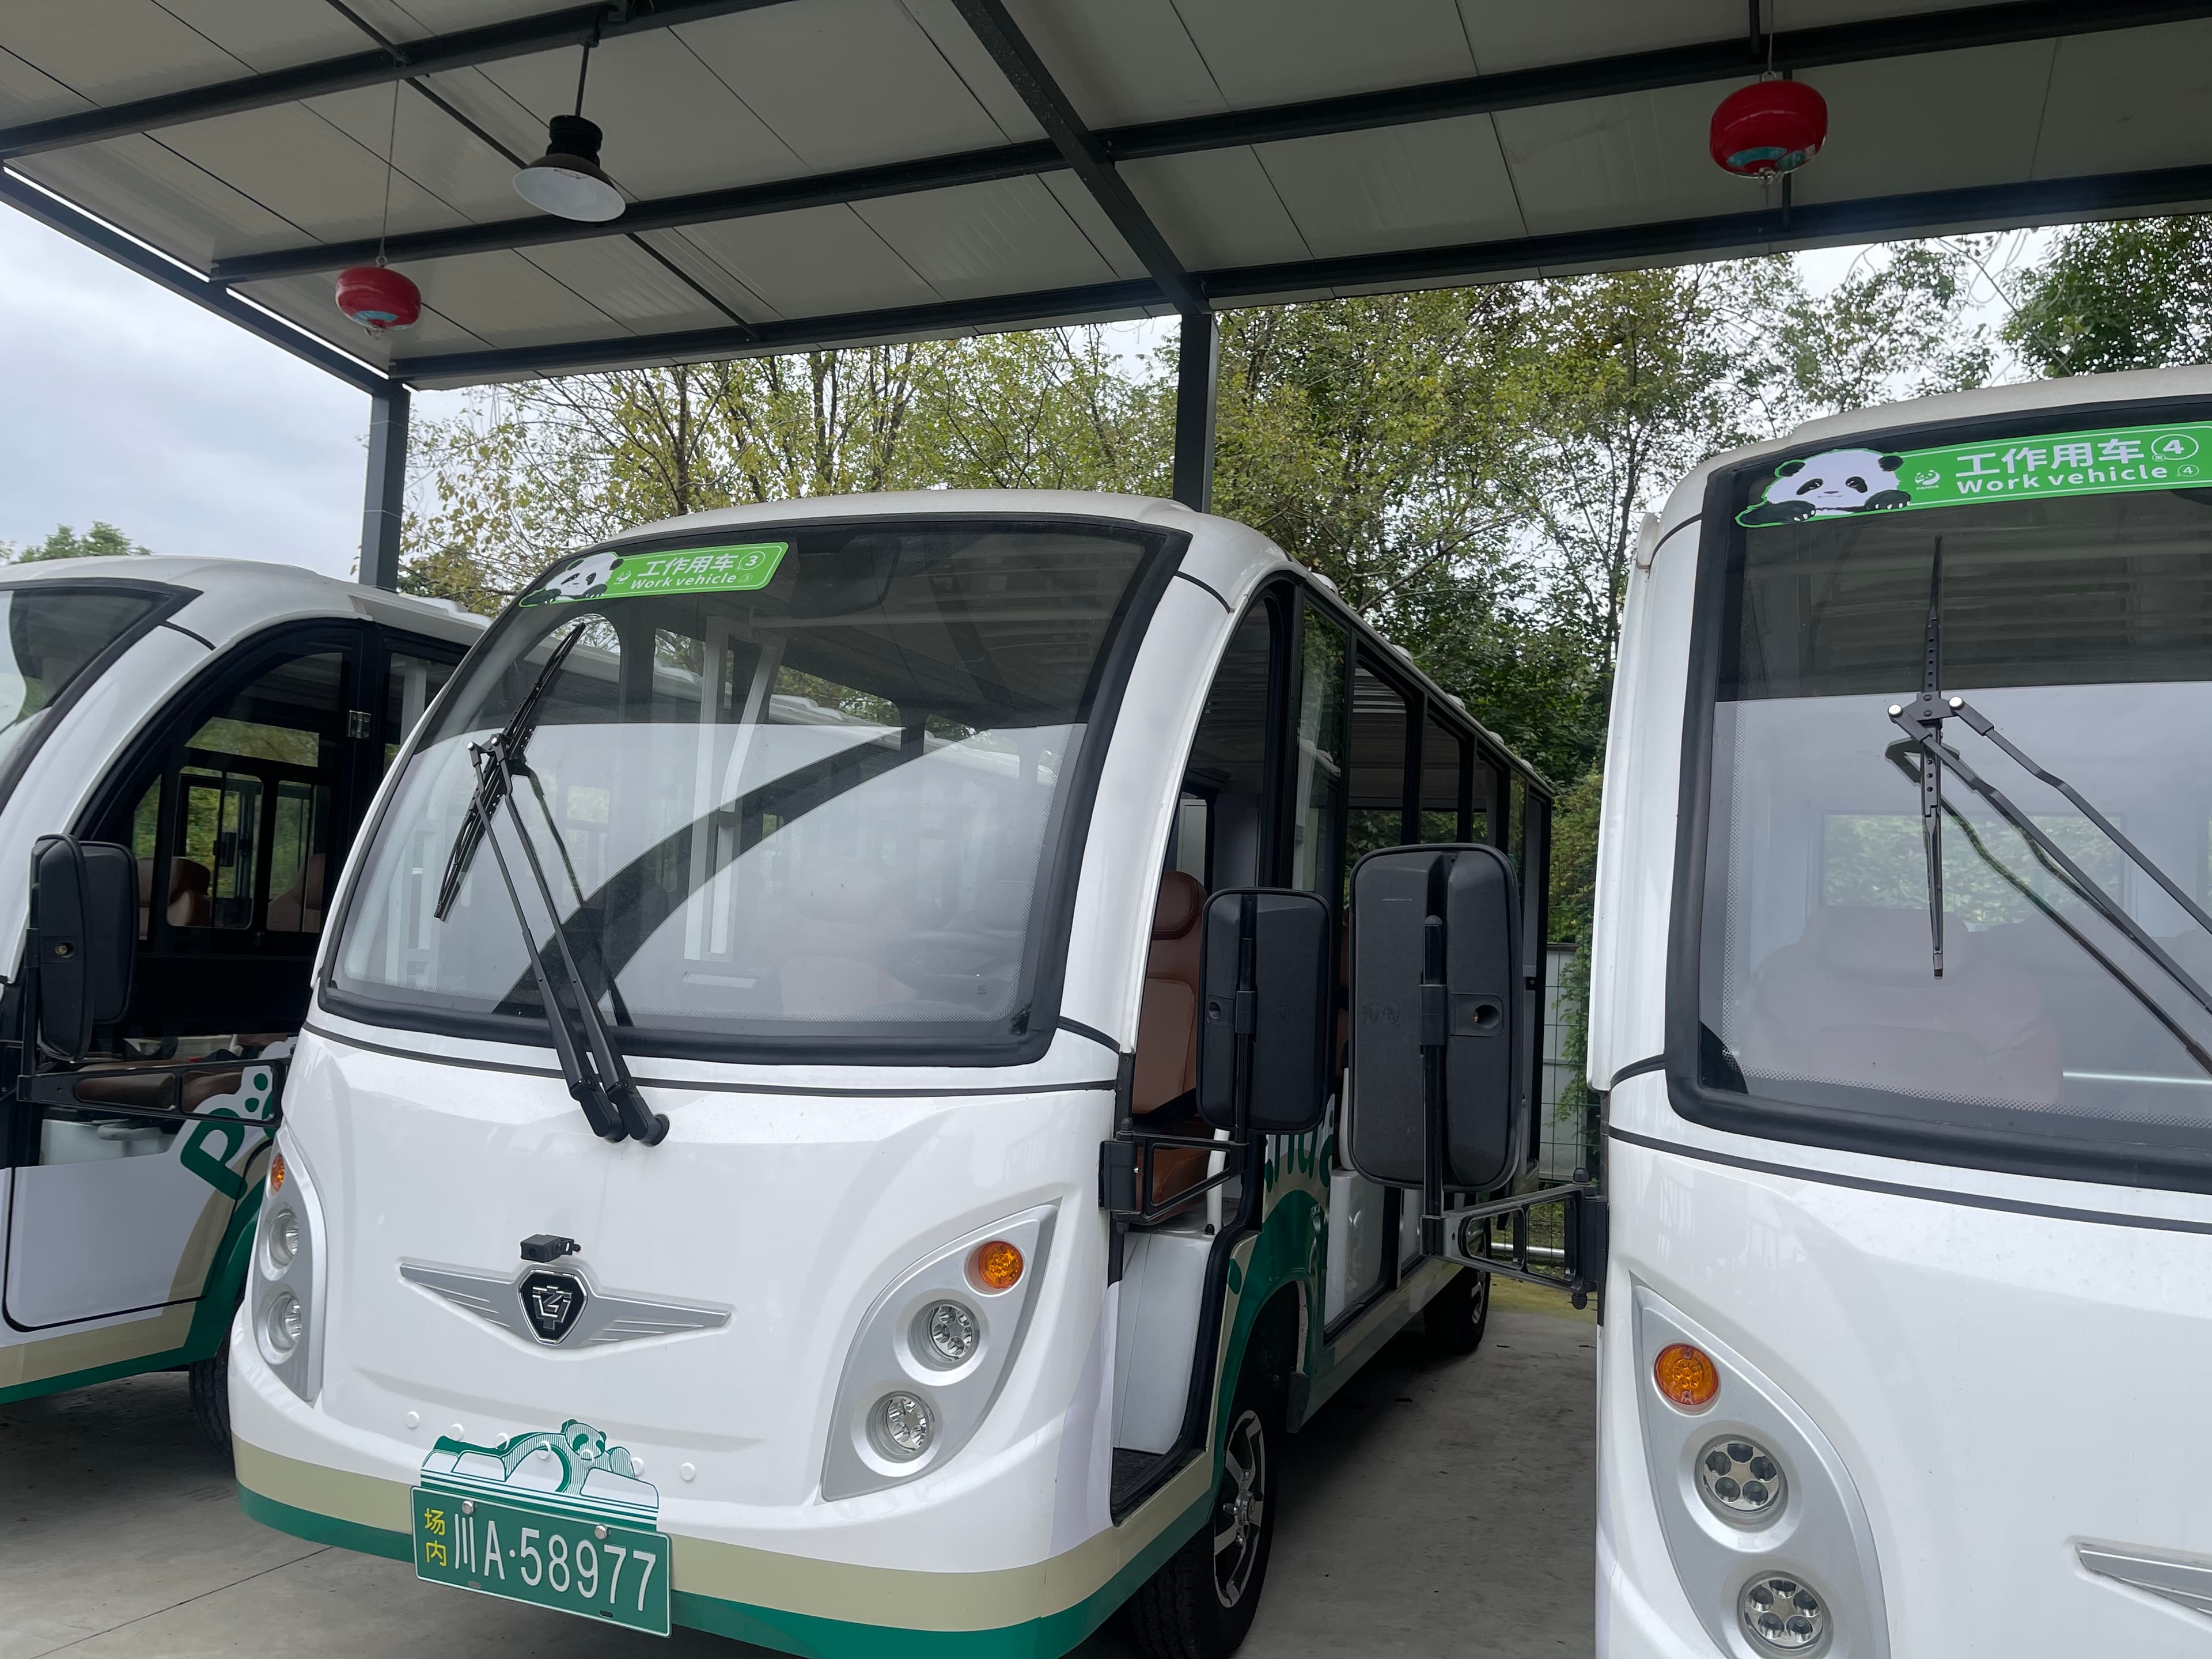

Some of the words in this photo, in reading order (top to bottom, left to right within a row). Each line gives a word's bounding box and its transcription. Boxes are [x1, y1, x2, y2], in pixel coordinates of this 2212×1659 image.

[1956, 438, 2144, 477] 工作用车
[1957, 474, 2040, 494] Work
[2048, 464, 2168, 486] vehicle
[637, 554, 738, 577] 工作用车
[630, 577, 673, 589] Work
[676, 573, 737, 586] vehicle
[424, 1508, 447, 1567] 场内
